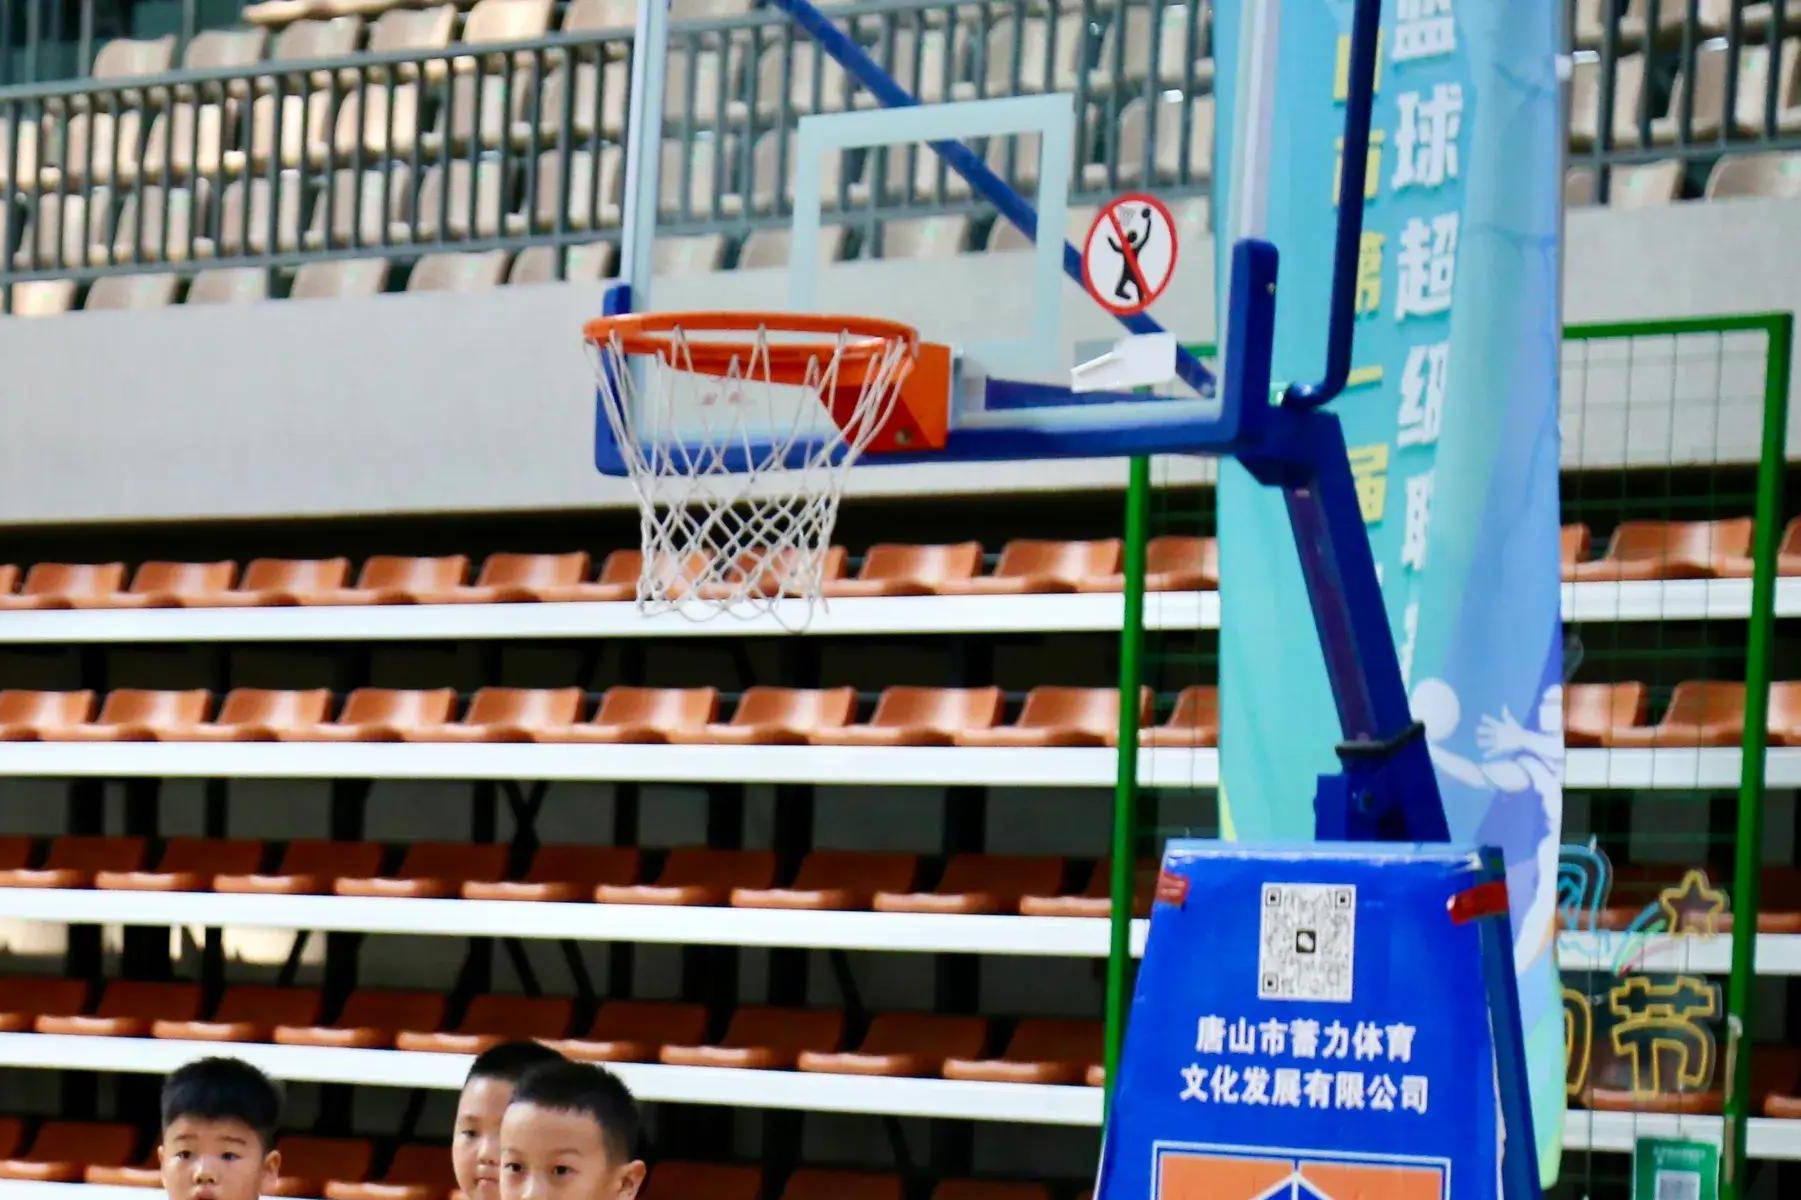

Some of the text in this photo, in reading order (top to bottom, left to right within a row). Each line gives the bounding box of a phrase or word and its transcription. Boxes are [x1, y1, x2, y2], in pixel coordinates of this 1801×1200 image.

[1196, 1014, 1417, 1063] 唐山市蓄力体育
[1179, 1062, 1429, 1115] 文化发展有限公司
